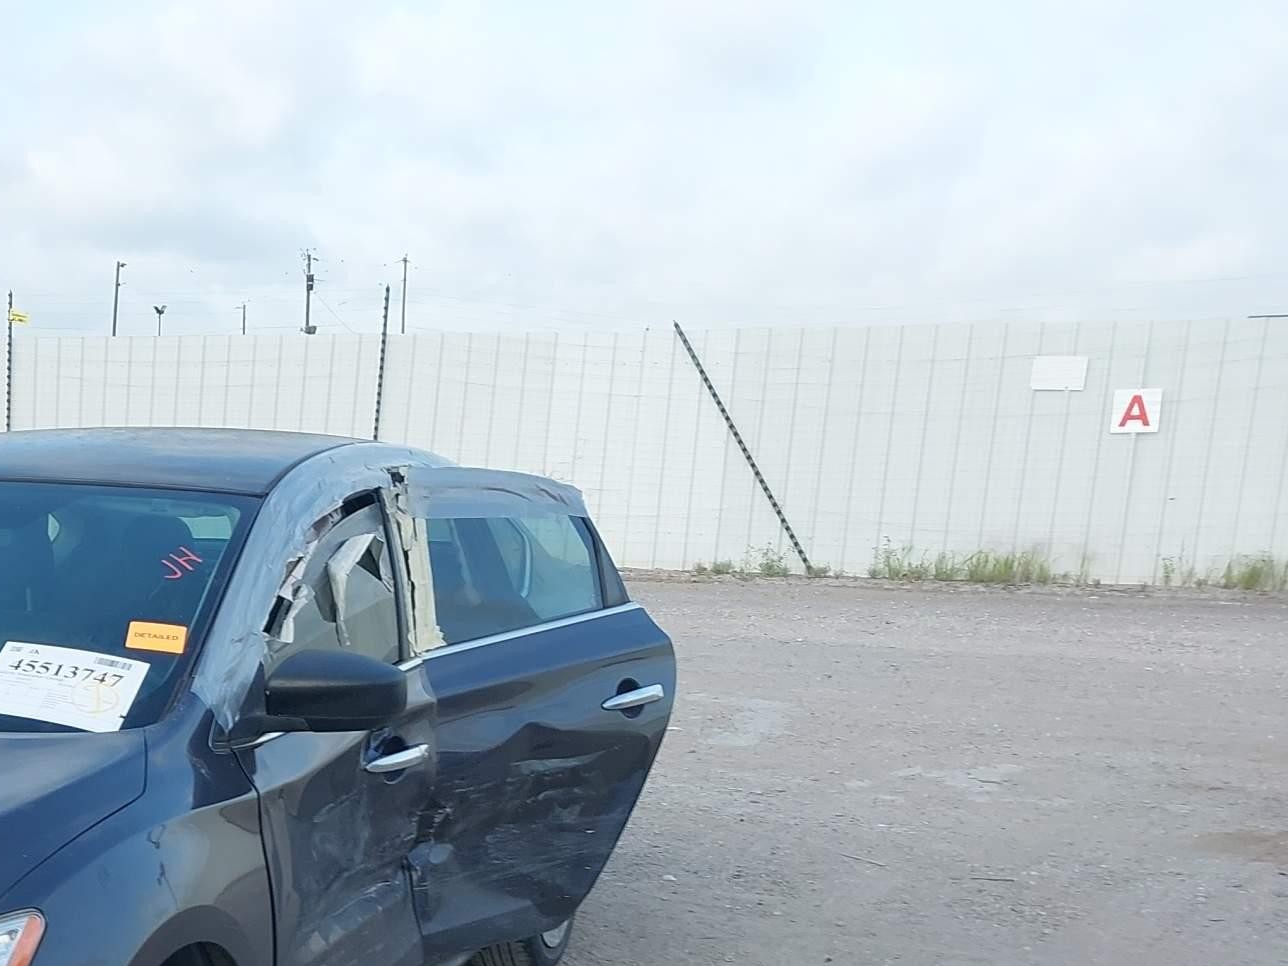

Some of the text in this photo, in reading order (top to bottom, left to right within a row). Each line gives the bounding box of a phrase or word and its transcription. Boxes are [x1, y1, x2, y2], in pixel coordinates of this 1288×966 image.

[1118, 394, 1151, 428] A
[133, 631, 179, 641] DETAILED
[8, 658, 124, 687] 45513747
